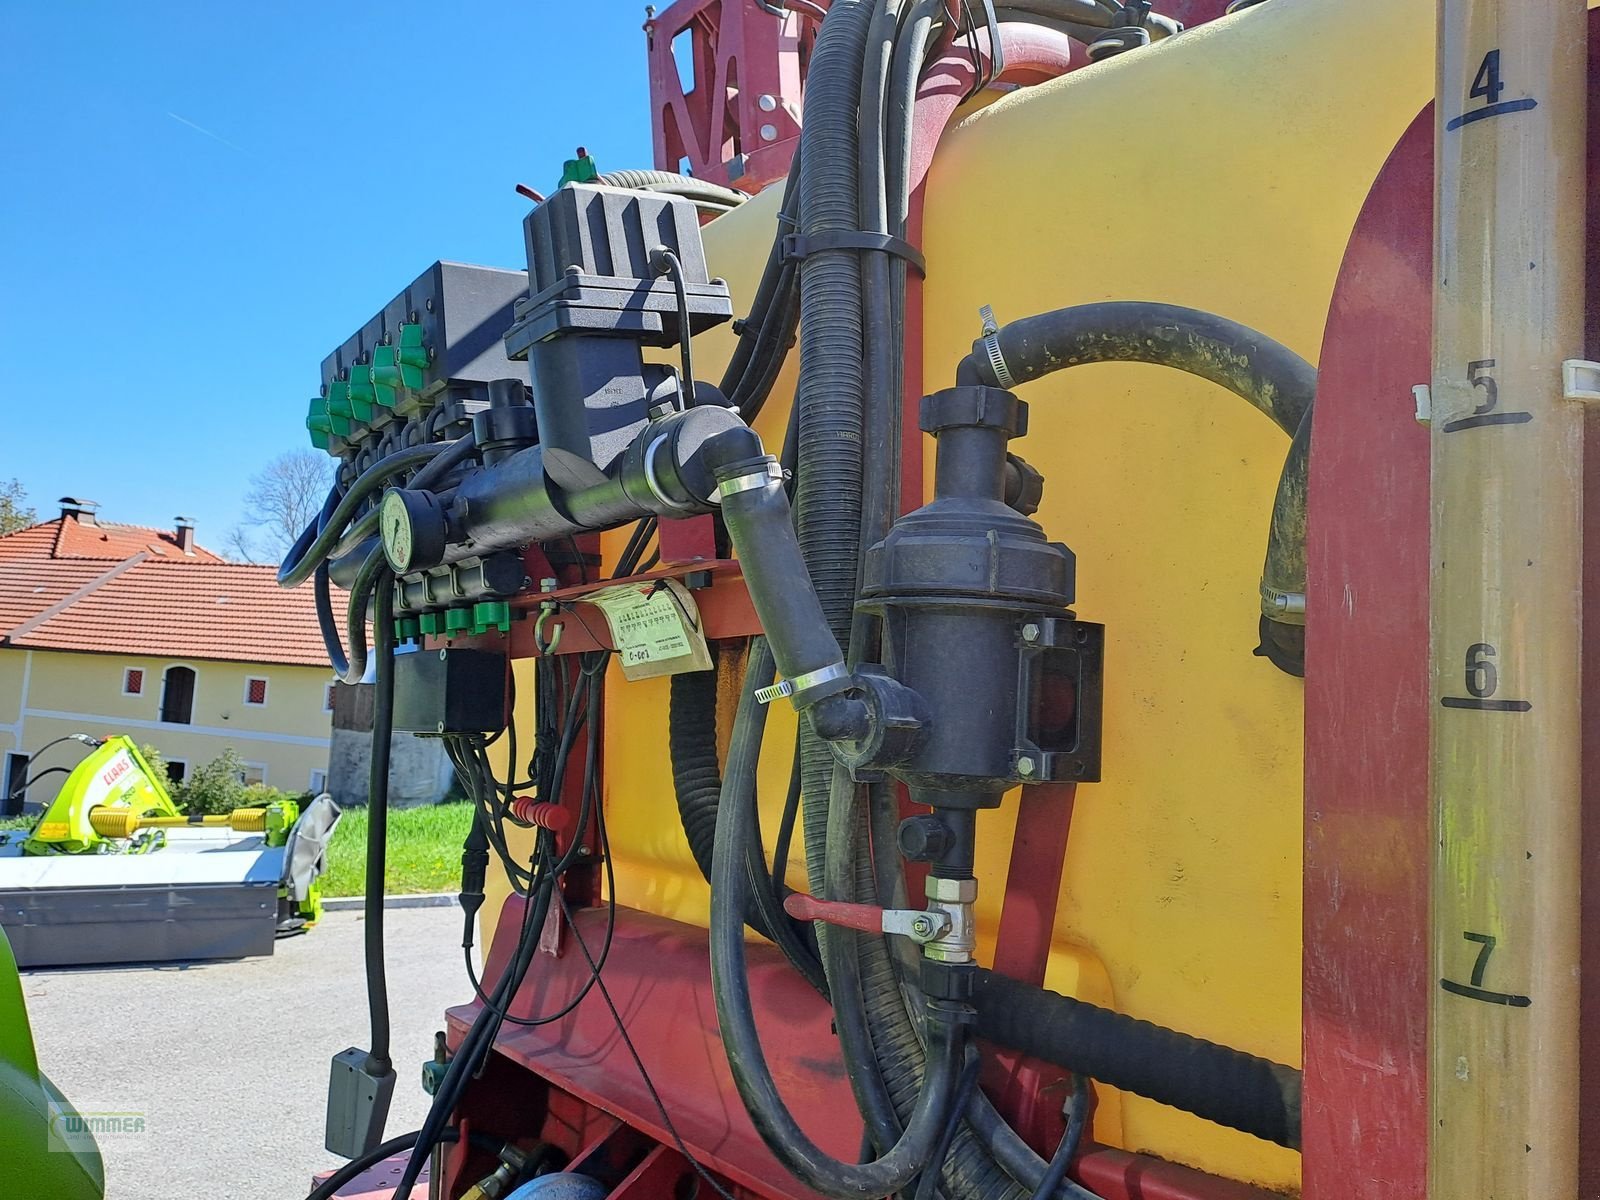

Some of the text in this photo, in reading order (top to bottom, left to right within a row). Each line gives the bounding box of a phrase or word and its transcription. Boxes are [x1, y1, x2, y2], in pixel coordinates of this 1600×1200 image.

[1469, 49, 1504, 104] 4
[1466, 359, 1498, 415] 5
[1465, 643, 1498, 699] 6
[103, 759, 129, 786] CLAAS
[1463, 931, 1497, 987] 7
